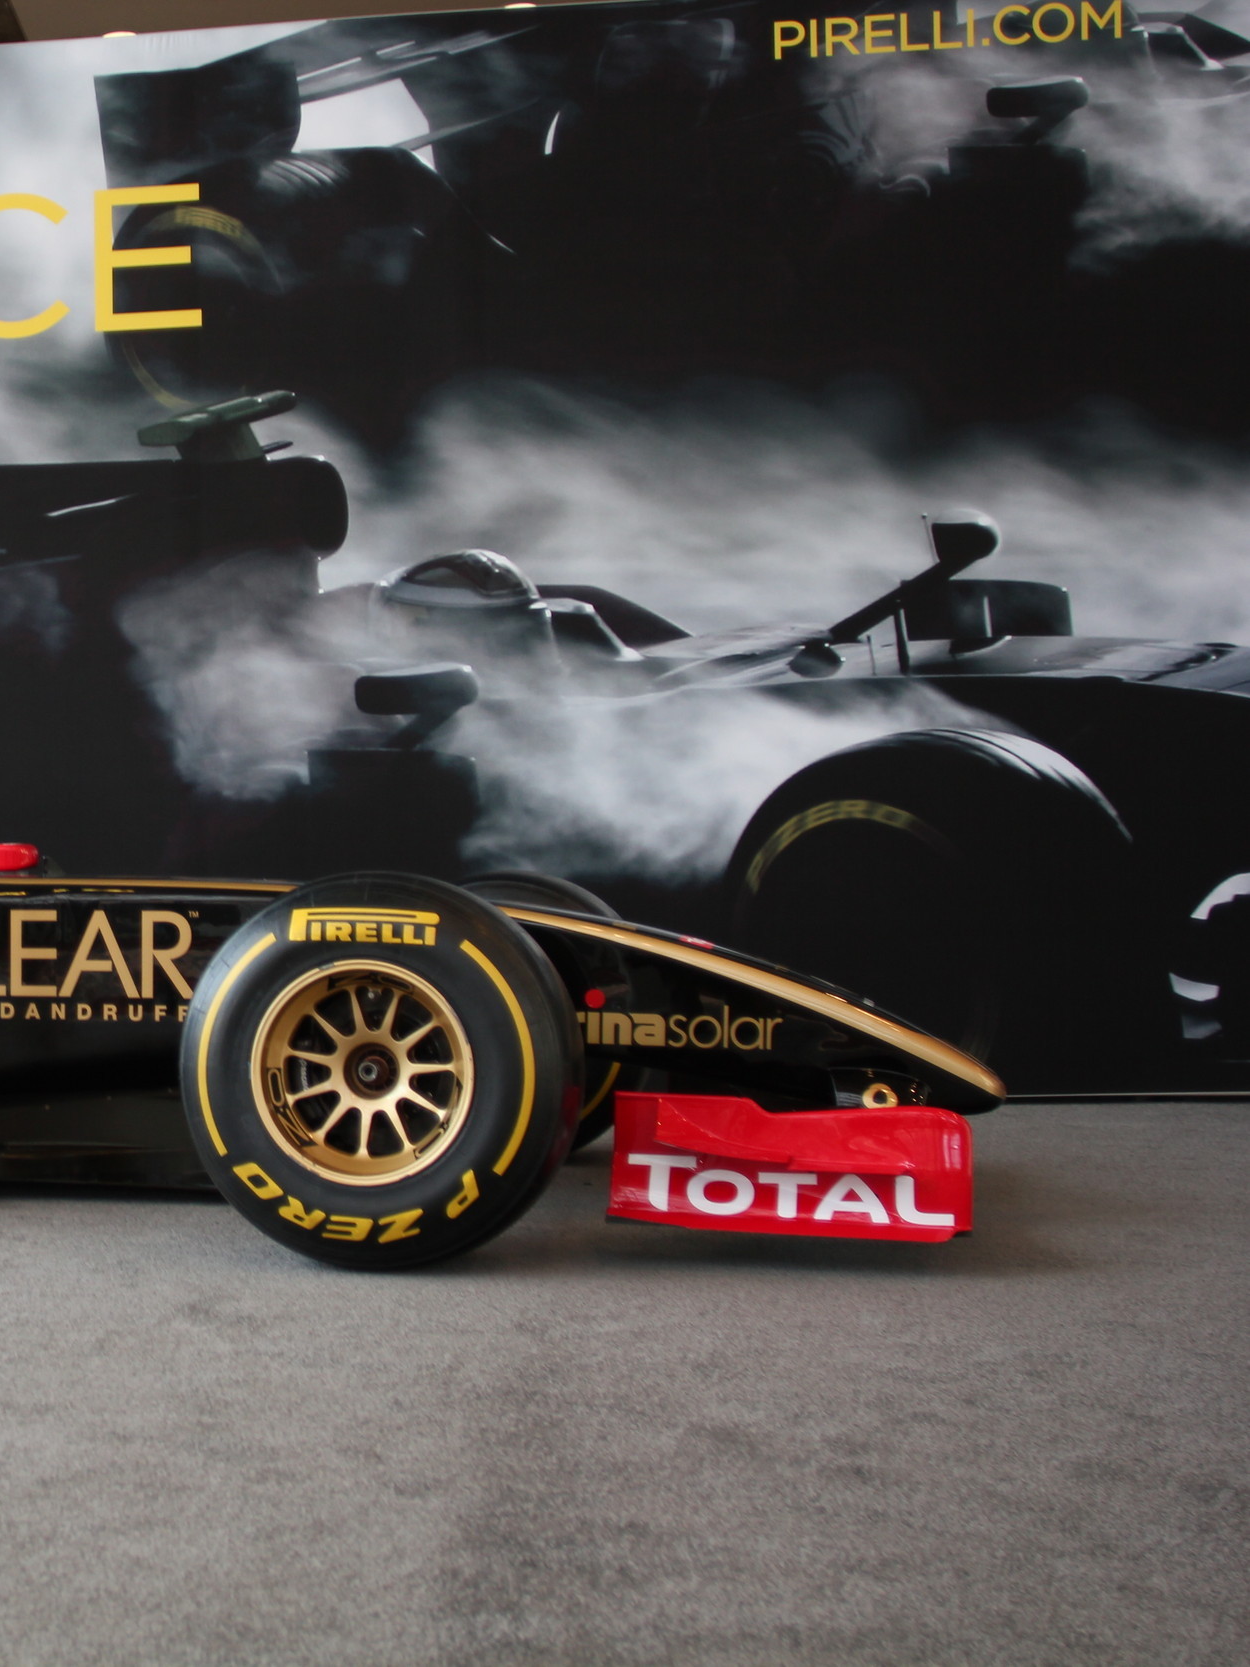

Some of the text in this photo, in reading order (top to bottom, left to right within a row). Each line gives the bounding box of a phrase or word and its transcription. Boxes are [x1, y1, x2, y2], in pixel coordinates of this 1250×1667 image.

[773, 0, 1123, 60] PIRELLI.COM
[289, 907, 440, 946] PIRELLI
[232, 1162, 480, 1244] P ZERO
[628, 1154, 955, 1226] TOTAL
